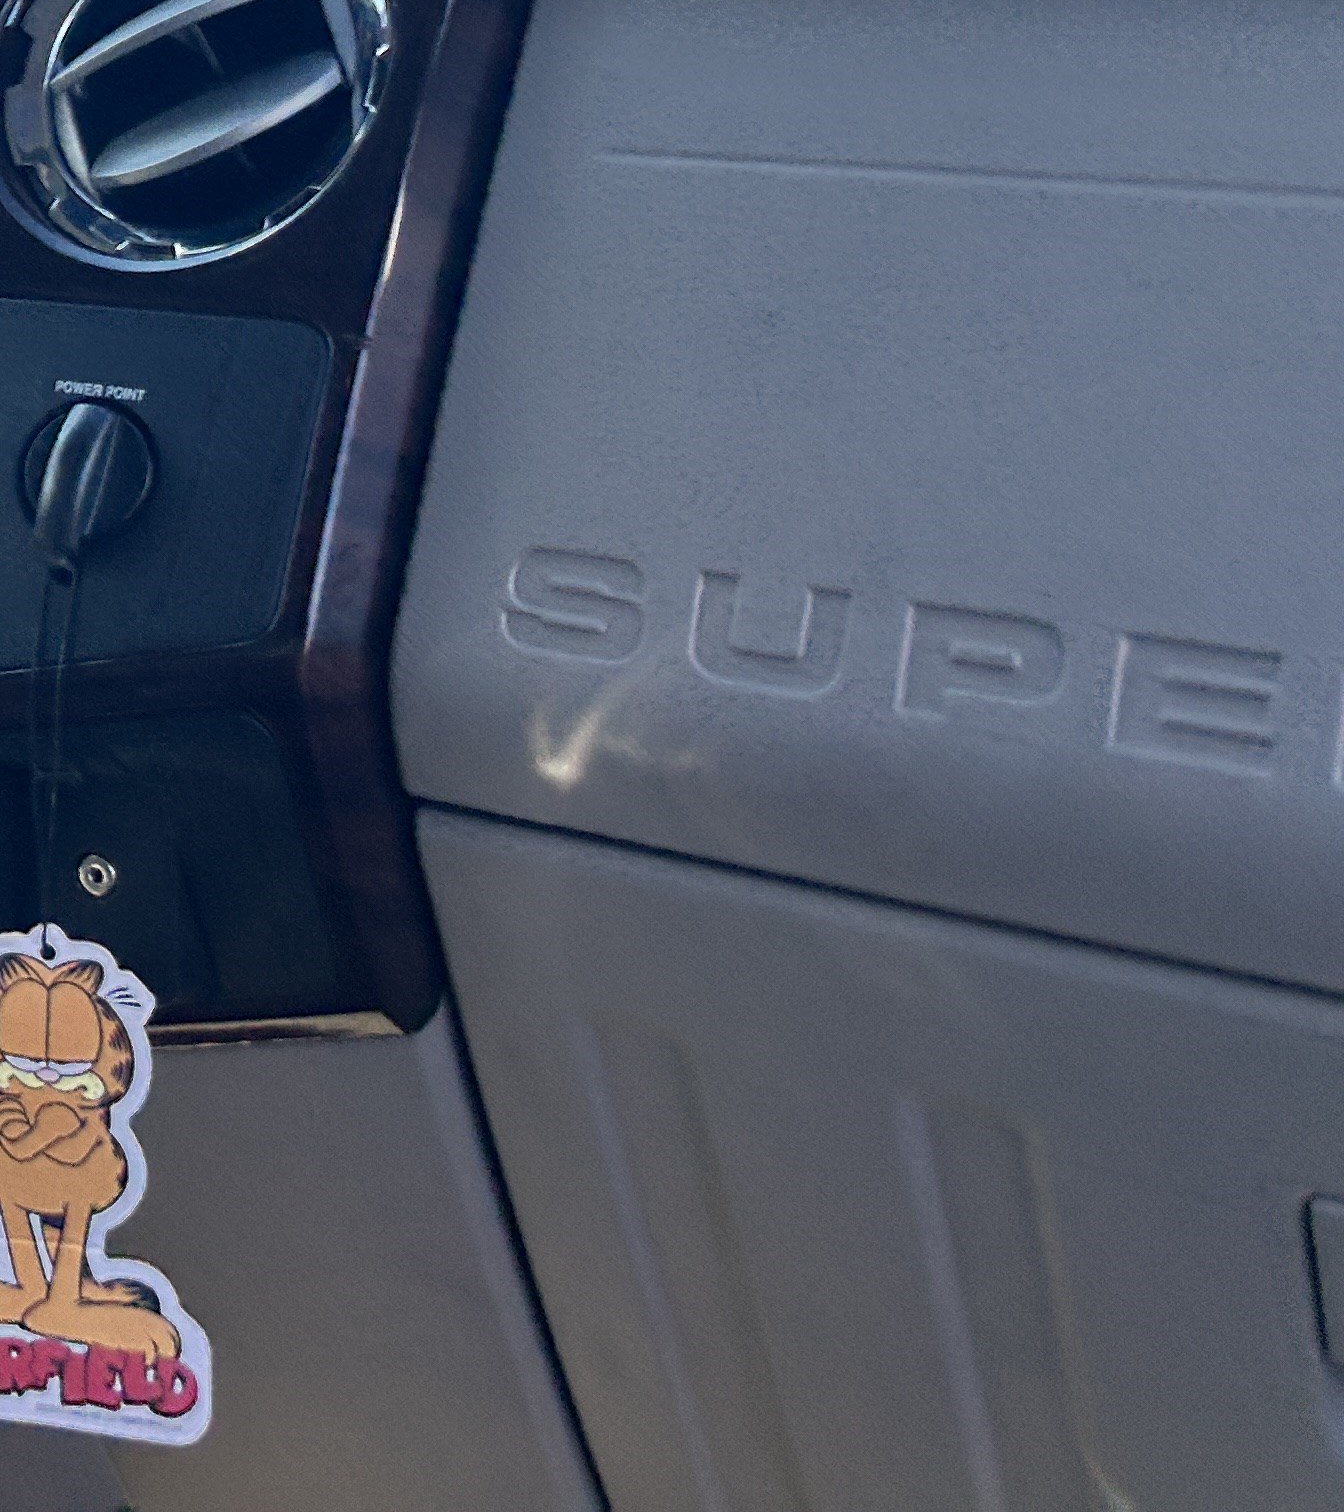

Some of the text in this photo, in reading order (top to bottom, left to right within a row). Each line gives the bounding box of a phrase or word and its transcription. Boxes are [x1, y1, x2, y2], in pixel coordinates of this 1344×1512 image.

[54, 380, 146, 402] POWER POINT
[502, 544, 1344, 786] SUPE
